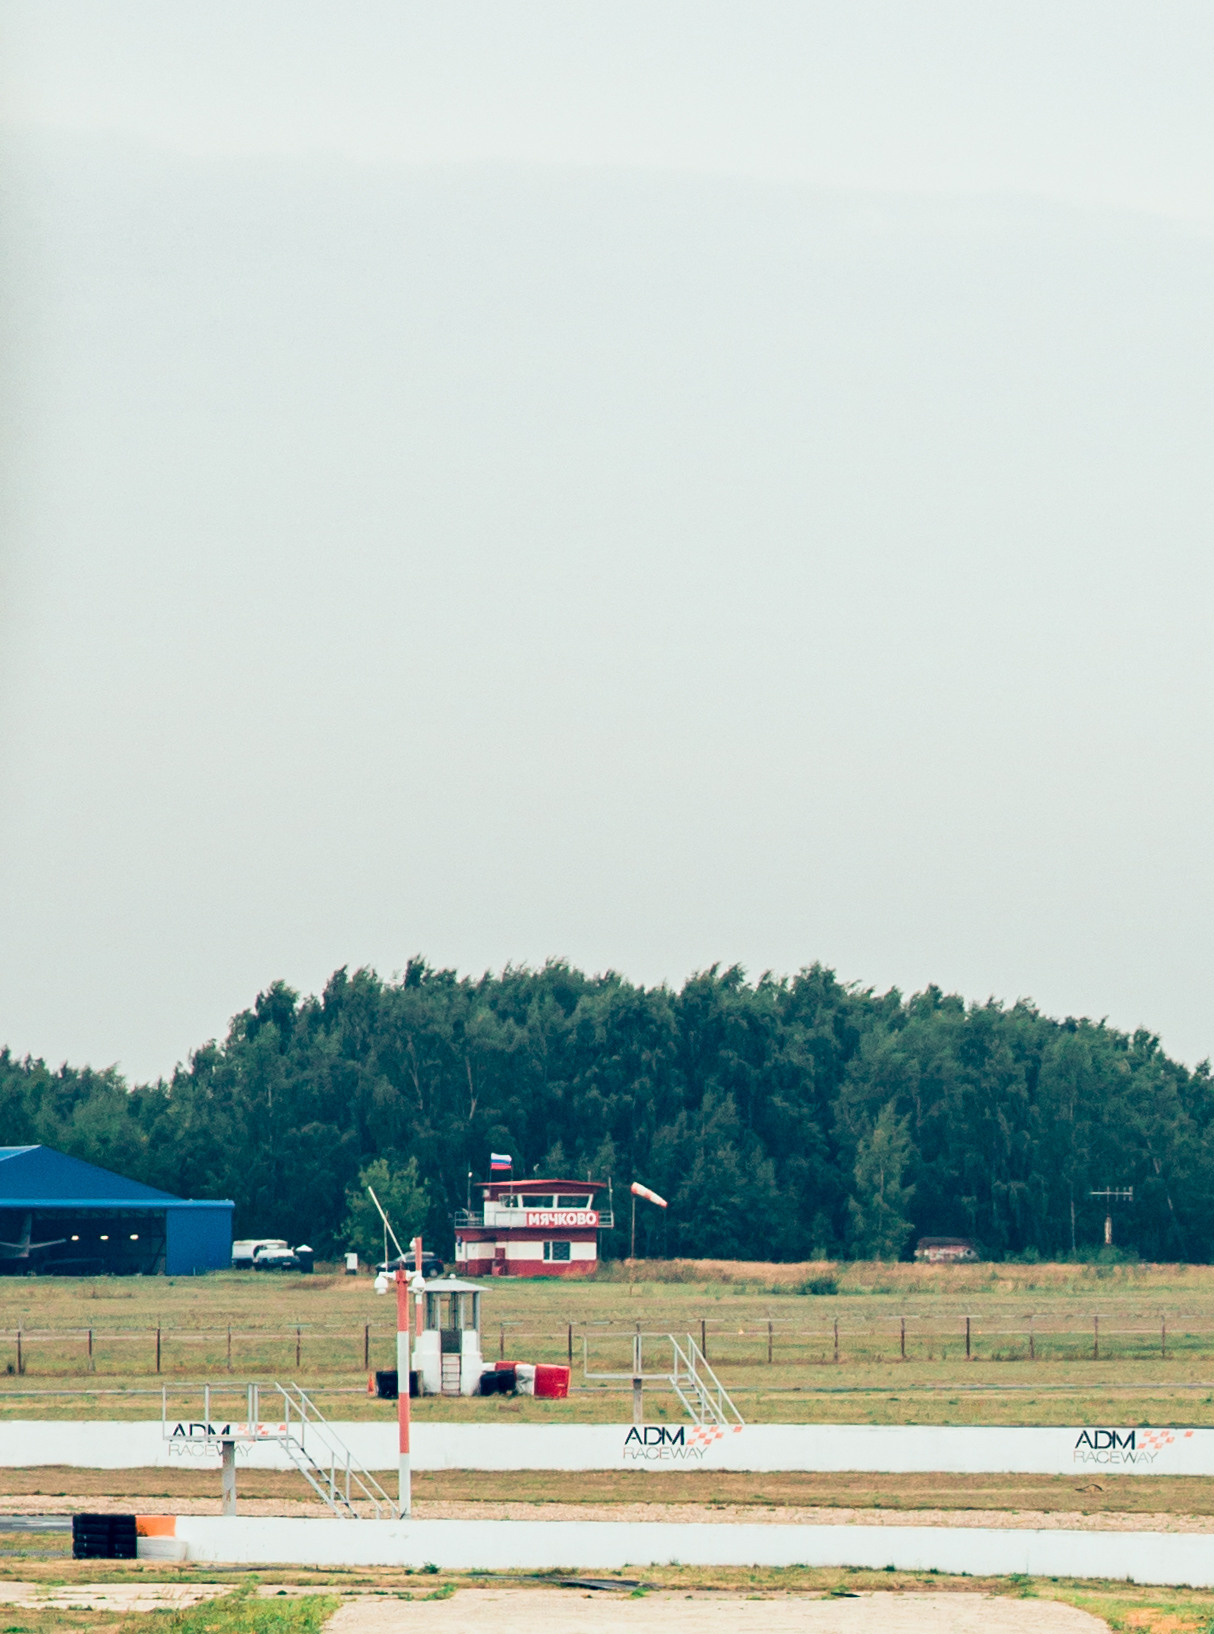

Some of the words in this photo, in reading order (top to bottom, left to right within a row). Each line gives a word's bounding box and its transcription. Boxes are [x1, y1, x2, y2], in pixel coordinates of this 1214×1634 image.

[528, 1212, 597, 1226] МЯЧКОВО
[172, 1423, 231, 1443] ADM
[624, 1426, 685, 1446] ADM
[1075, 1430, 1136, 1450] ADM
[623, 1446, 708, 1460] RACEWAY
[1073, 1450, 1158, 1464] RACEWAY
